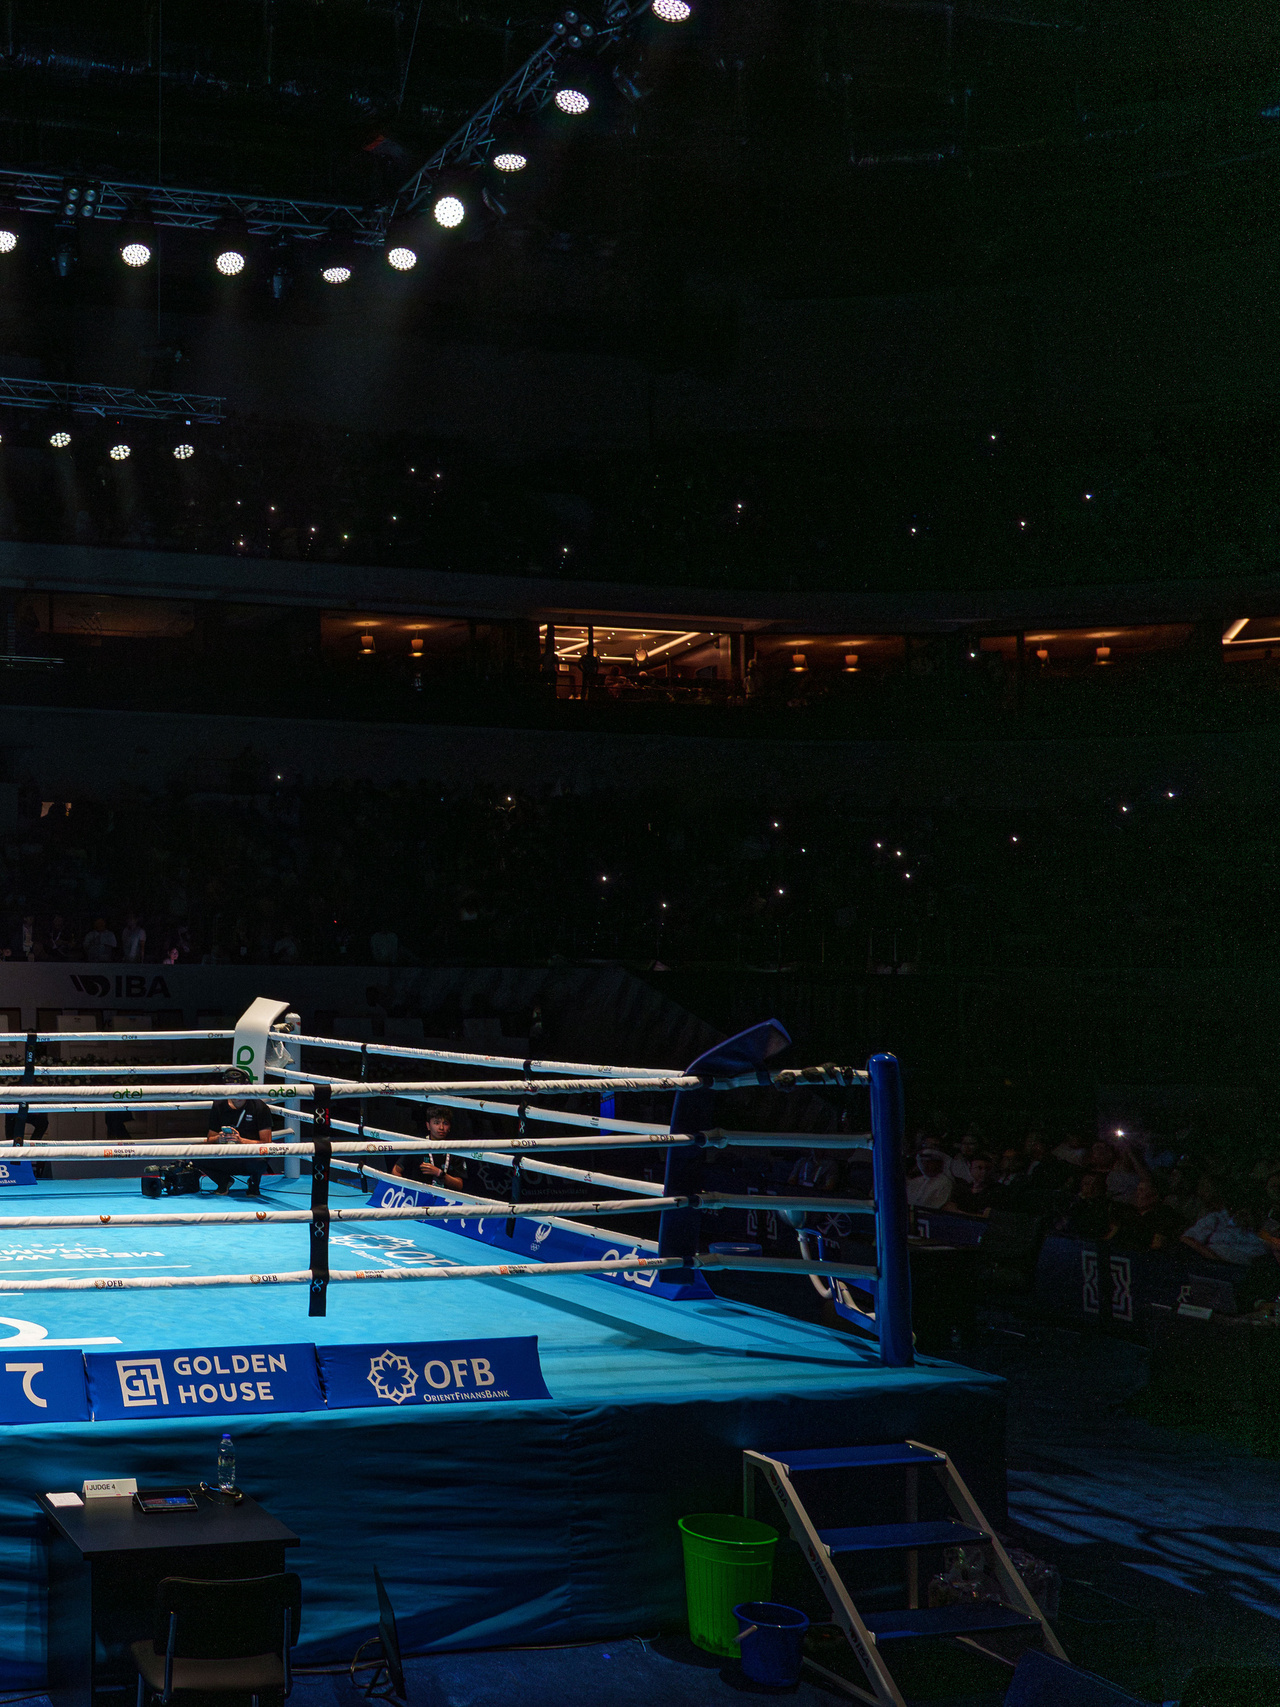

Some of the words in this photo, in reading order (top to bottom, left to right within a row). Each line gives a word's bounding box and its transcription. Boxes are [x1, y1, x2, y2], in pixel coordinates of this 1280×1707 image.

[115, 975, 171, 998] IBA
[112, 1088, 143, 1100] artel
[268, 1086, 297, 1097] artel
[522, 1139, 537, 1147] OFB
[60, 1251, 166, 1260] MENS
[384, 1251, 461, 1267] OF
[107, 1280, 123, 1288] OFB
[262, 1274, 278, 1282] OFB
[173, 1353, 288, 1377] GOLDEN
[424, 1357, 496, 1390] OFB
[178, 1380, 275, 1405] HOUSE
[776, 1484, 789, 1508] IBA
